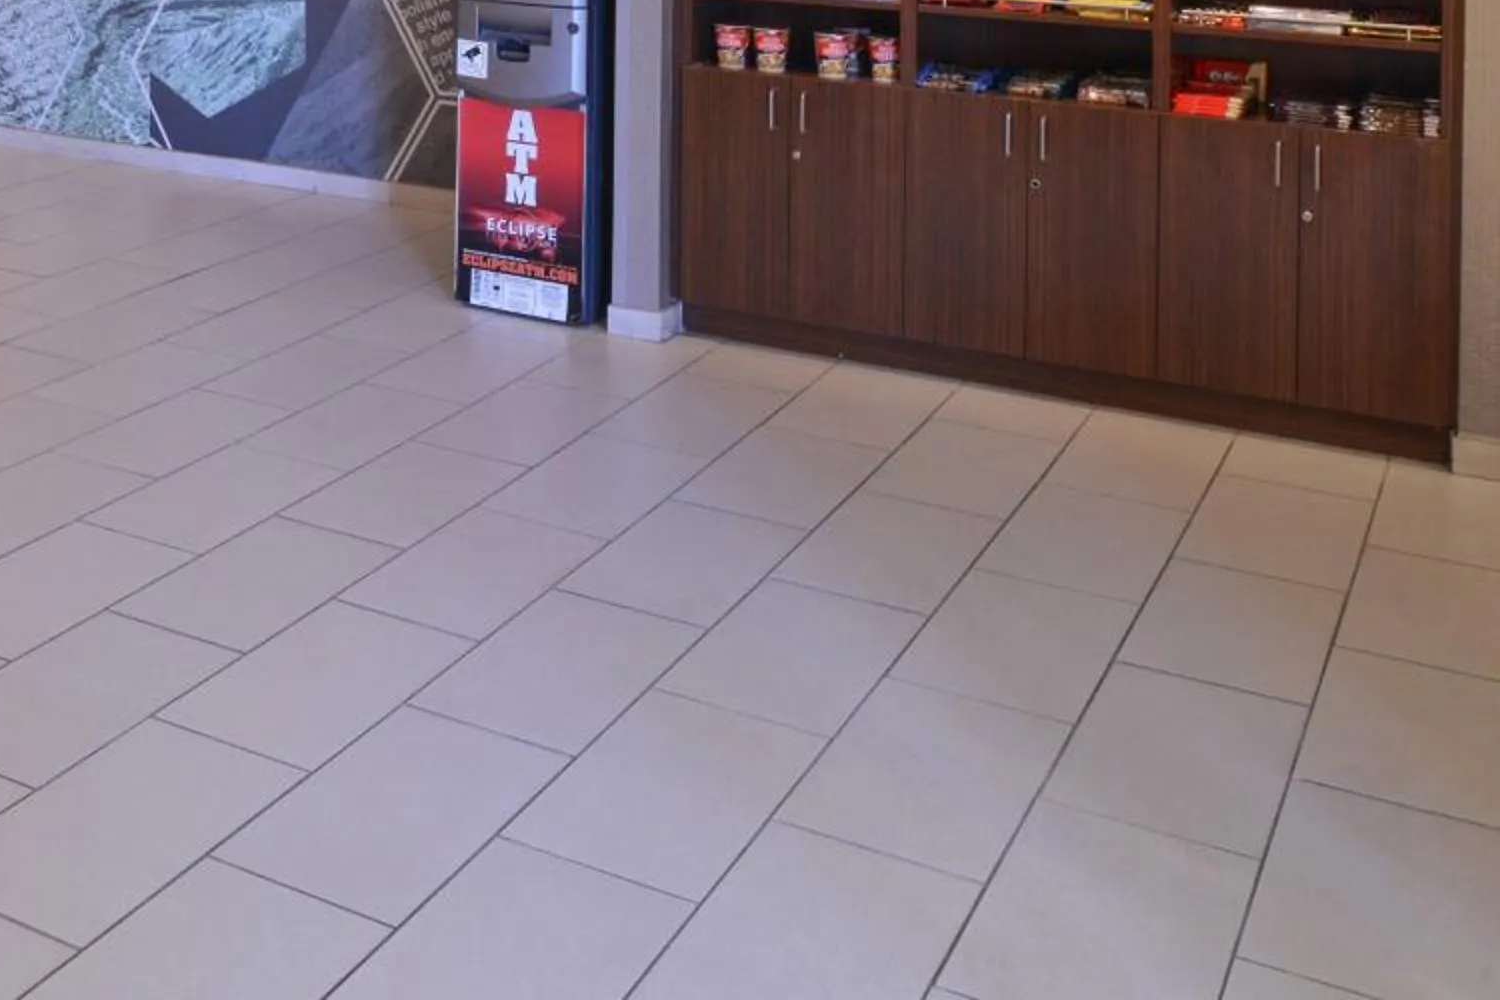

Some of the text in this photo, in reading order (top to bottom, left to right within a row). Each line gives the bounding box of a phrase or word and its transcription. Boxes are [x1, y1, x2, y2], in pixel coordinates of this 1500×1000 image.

[414, 10, 452, 34] style
[505, 109, 538, 207] ATM
[486, 217, 558, 243] ECLIPSE
